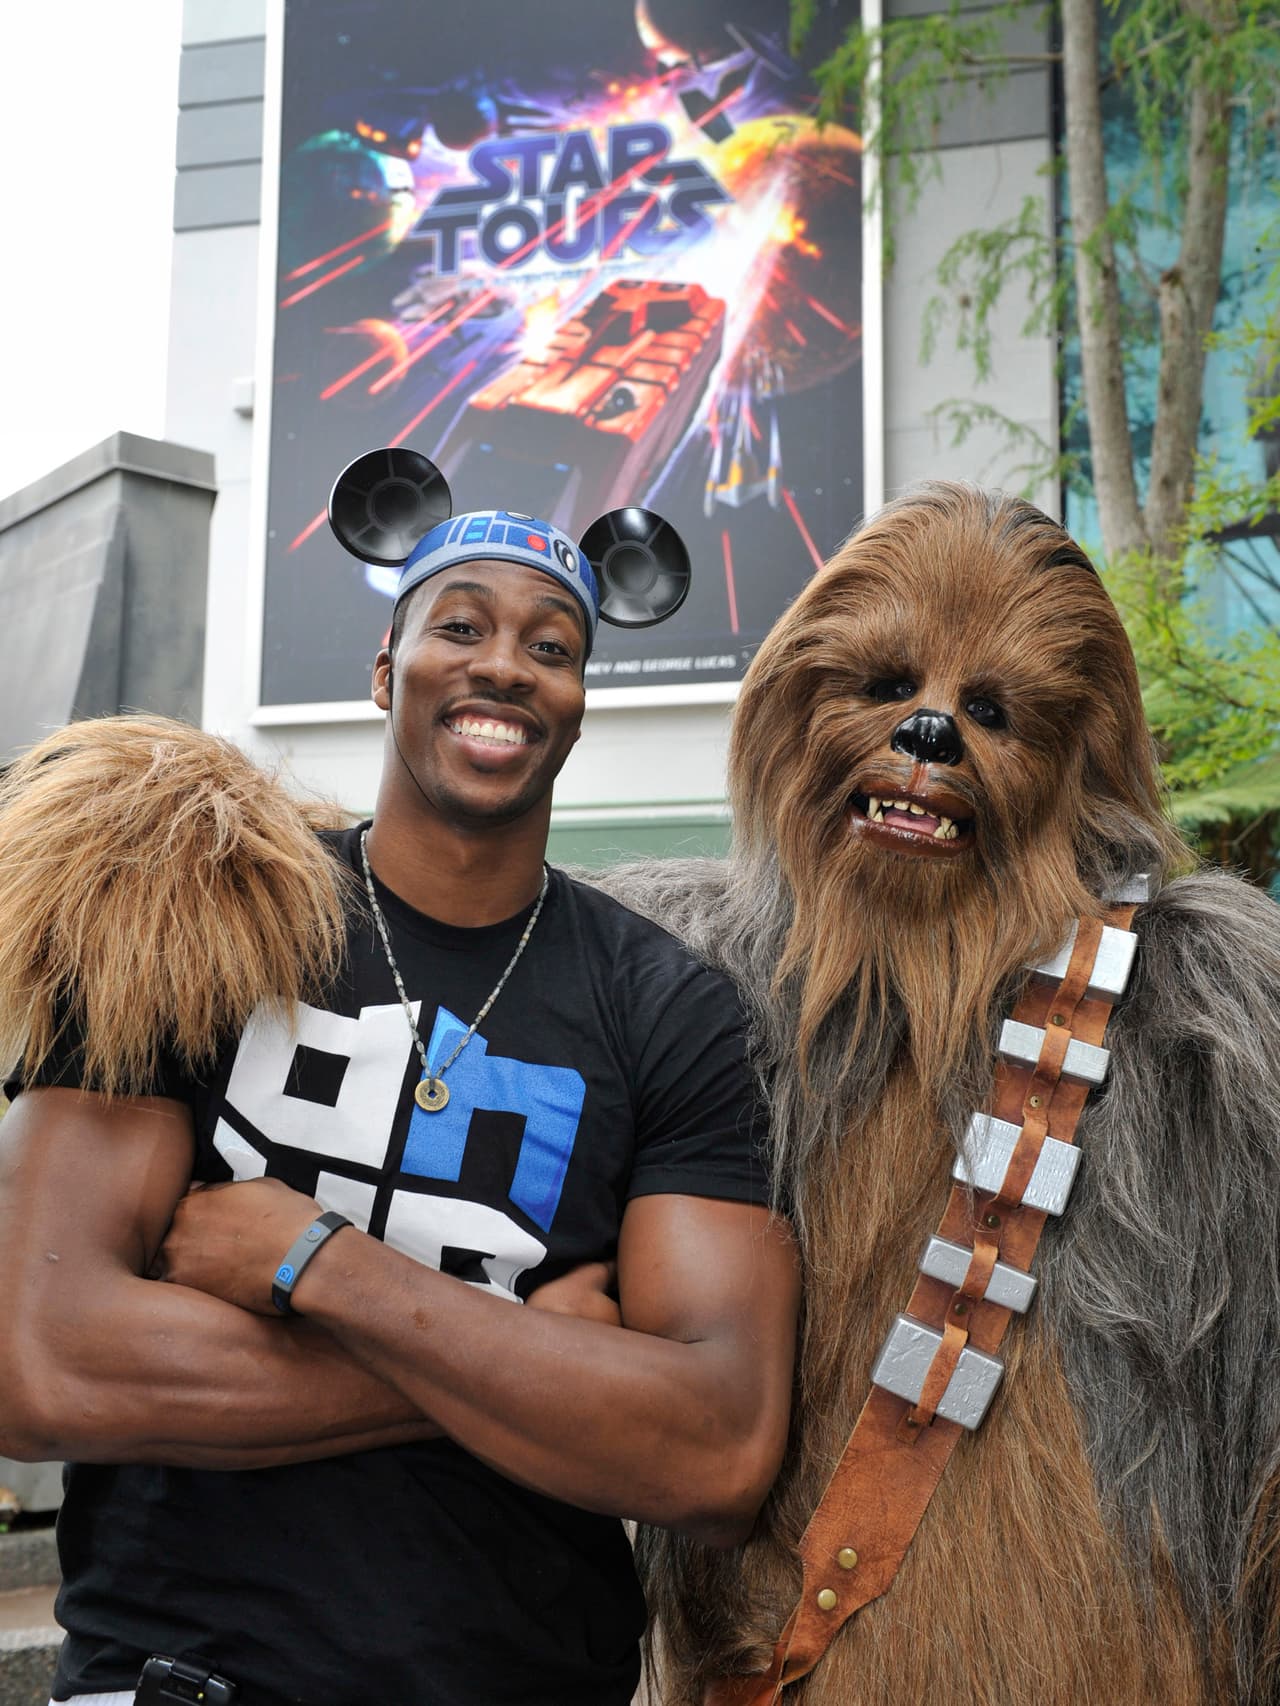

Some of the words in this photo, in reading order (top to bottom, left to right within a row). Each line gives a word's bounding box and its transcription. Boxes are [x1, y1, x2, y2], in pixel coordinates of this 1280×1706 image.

[429, 122, 722, 207] STAR
[408, 184, 735, 276] TOURS
[614, 660, 641, 674] AND
[643, 657, 691, 672] GEORGE
[695, 655, 737, 670] LUCAS
